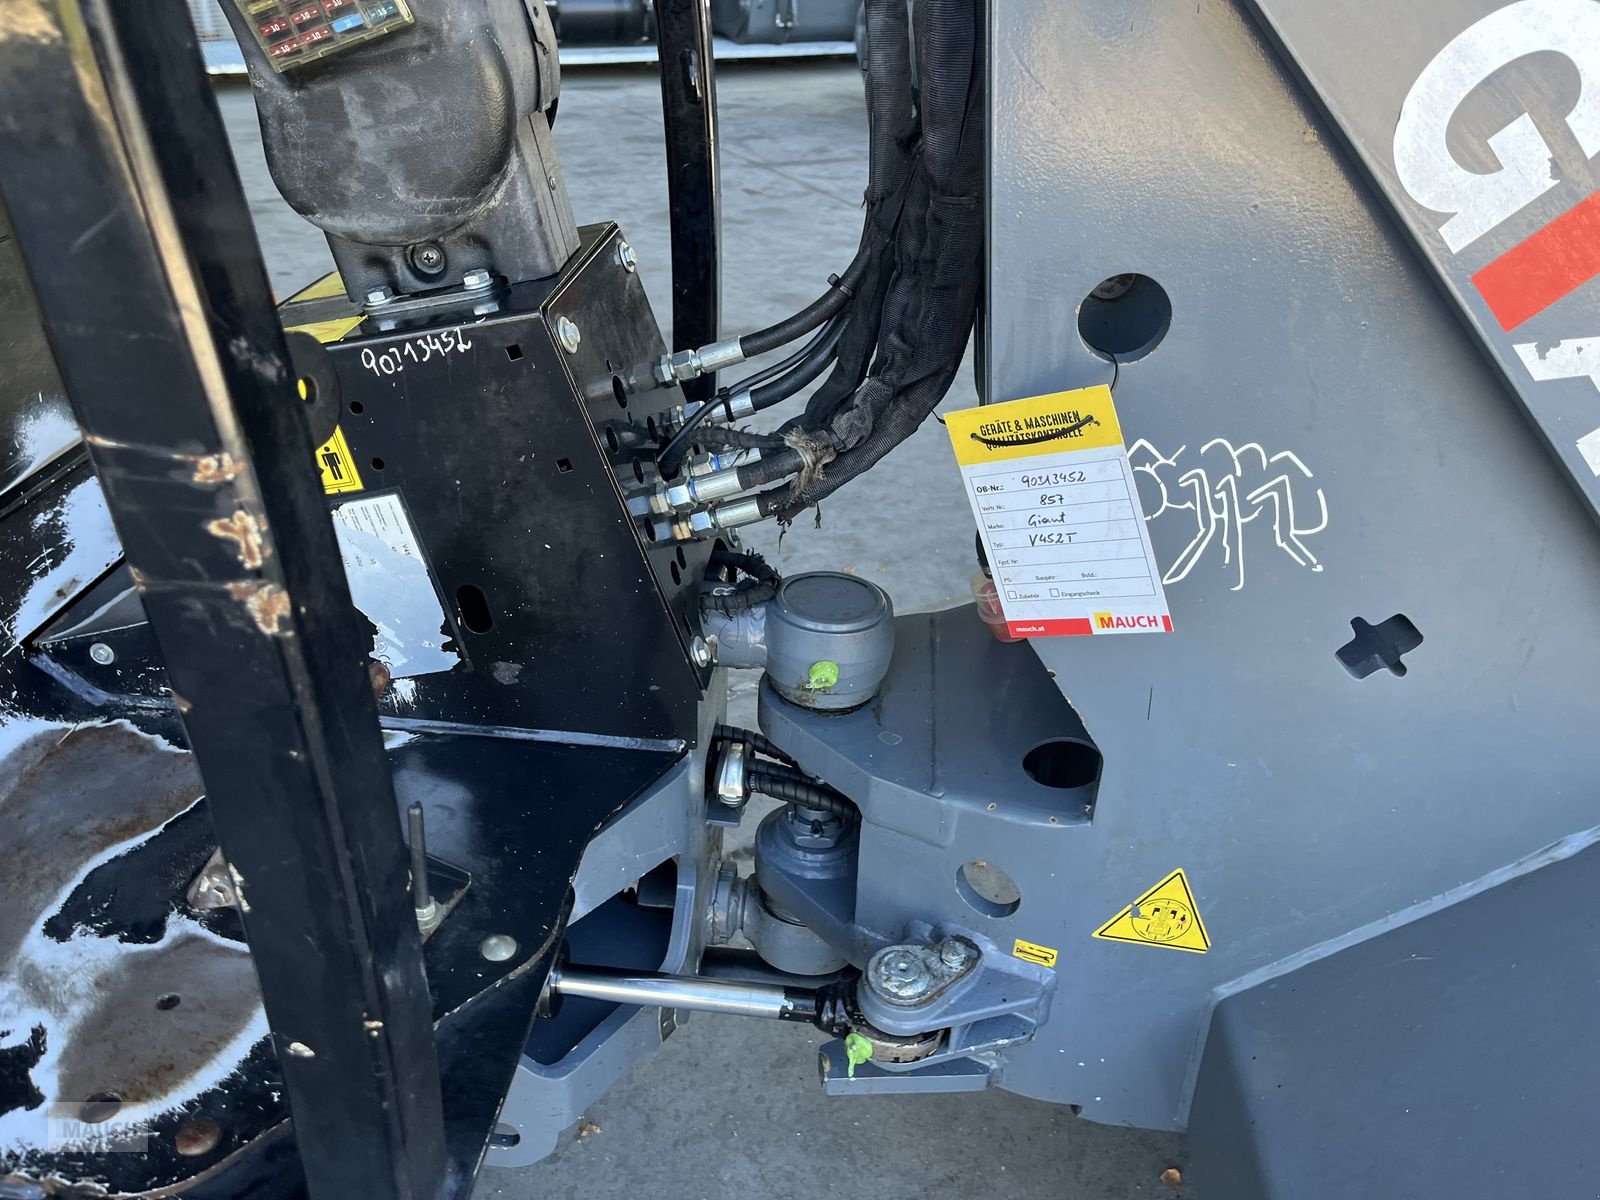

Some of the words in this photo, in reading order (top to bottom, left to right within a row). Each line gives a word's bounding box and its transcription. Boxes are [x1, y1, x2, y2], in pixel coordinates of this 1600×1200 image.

[300, 11, 311, 21] 10
[270, 23, 281, 33] 10
[311, 31, 322, 41] 10
[280, 44, 291, 53] 10
[979, 419, 1013, 437] GERÄTE
[1014, 419, 1023, 431] &
[1023, 410, 1081, 430] MASCHINEN
[1040, 494, 1064, 505] 857
[1028, 511, 1066, 528] Giant
[1028, 532, 1078, 547] V452T
[1015, 625, 1046, 633] mauch.at
[1099, 615, 1159, 629] MAUCH
